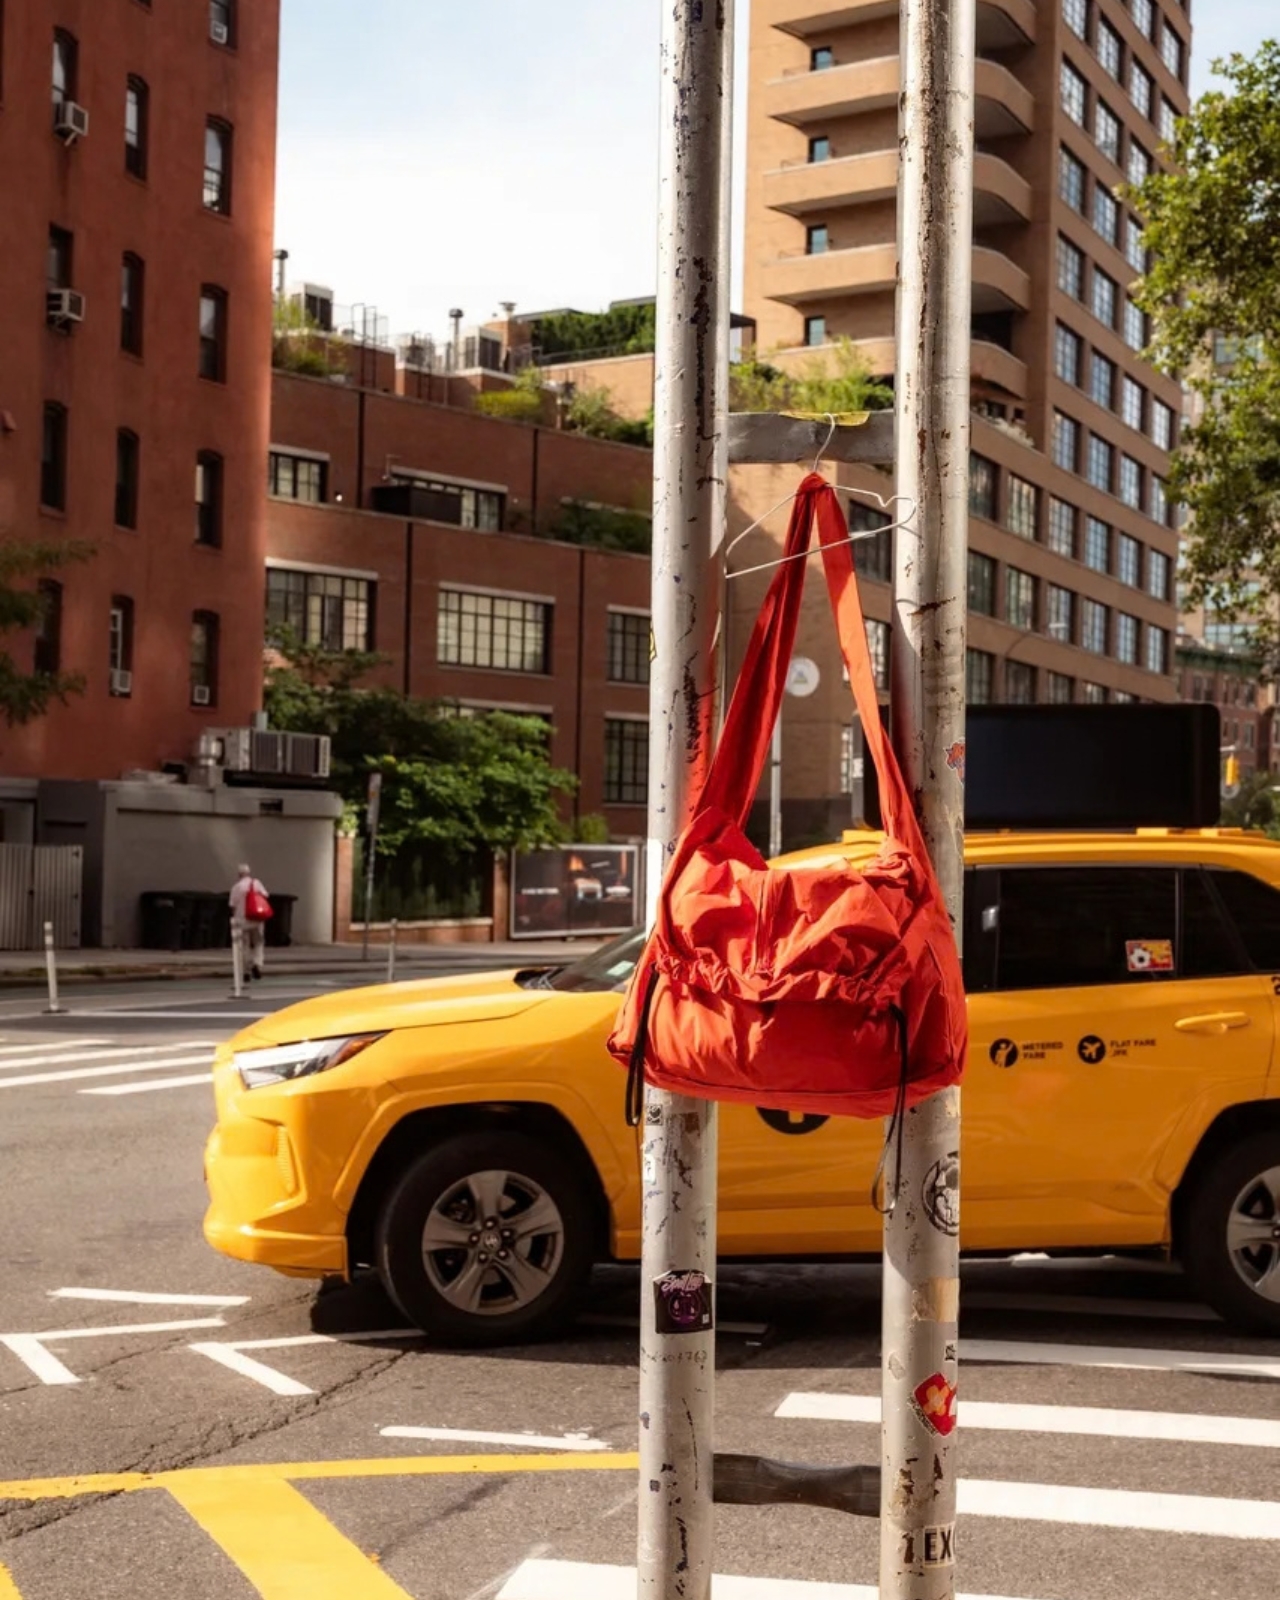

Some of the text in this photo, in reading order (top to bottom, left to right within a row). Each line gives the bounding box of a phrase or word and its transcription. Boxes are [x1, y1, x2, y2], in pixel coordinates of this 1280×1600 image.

[1022, 1041, 1063, 1050] METERED
[1110, 1038, 1156, 1049] FLAT FARE
[1023, 1051, 1046, 1059] FARE
